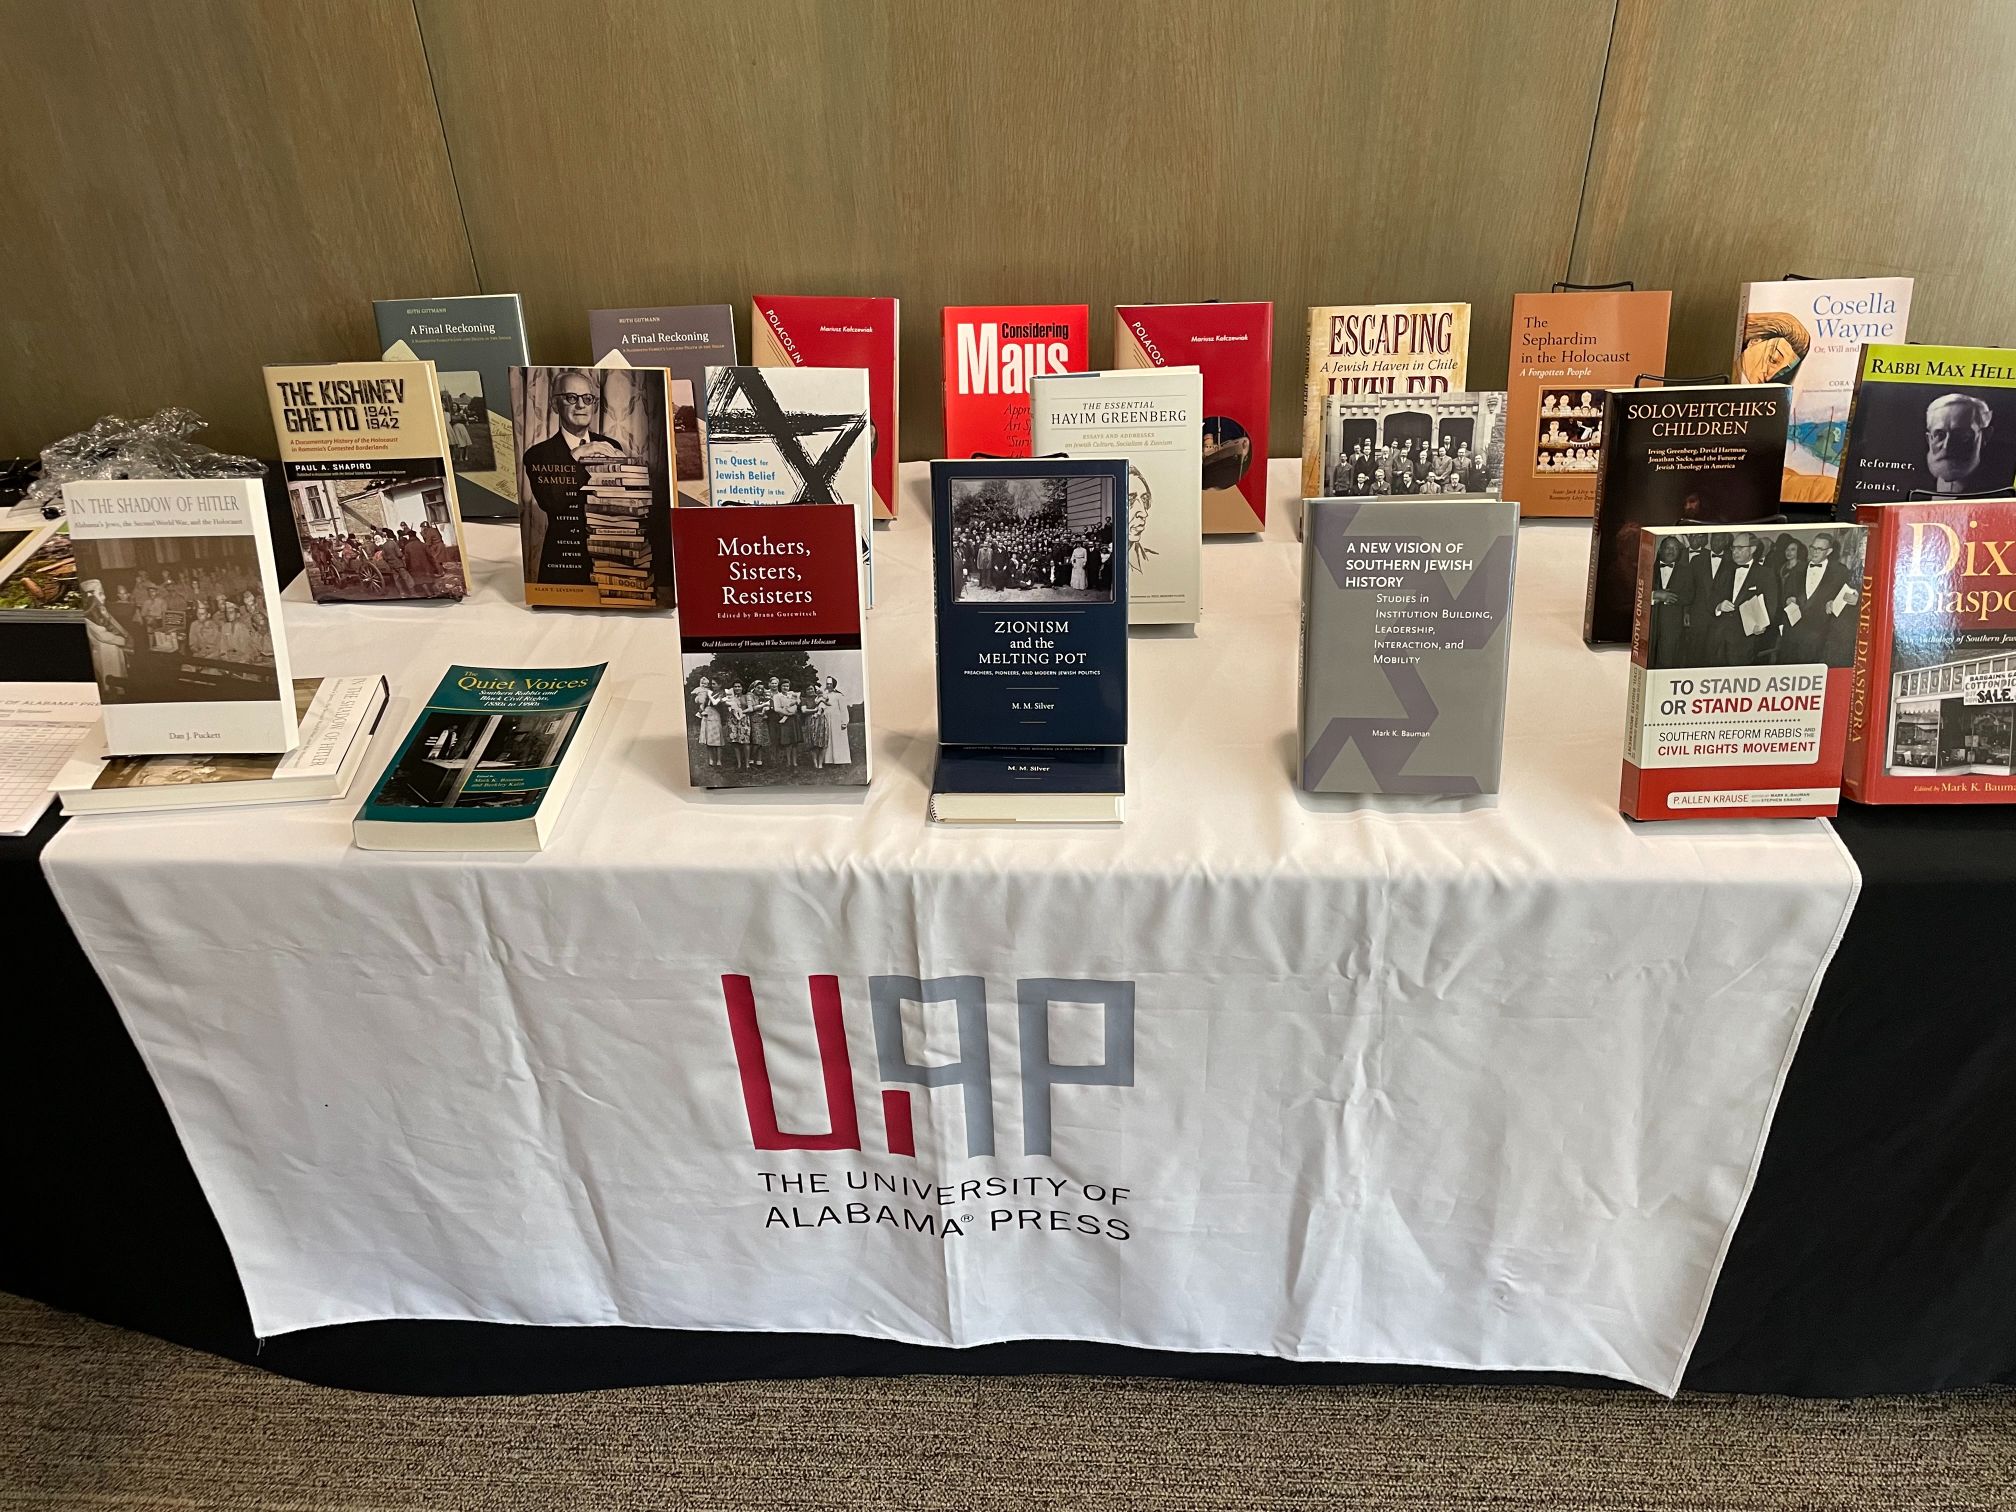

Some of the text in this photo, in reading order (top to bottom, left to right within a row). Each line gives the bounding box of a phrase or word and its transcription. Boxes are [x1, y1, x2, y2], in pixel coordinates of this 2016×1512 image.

[1813, 292, 1897, 316] Cosella
[410, 322, 496, 334] A Final Reckoning
[1524, 316, 1548, 328] The
[622, 331, 710, 344] A Final Reckoning
[766, 309, 804, 364] POLACOS IN
[1002, 322, 1069, 340] Considering
[1328, 312, 1453, 357] ESCAPING
[1815, 318, 1894, 344] Wayne
[1132, 321, 1165, 365] POLACOS
[1522, 332, 1597, 350] Sephardim
[1814, 346, 1826, 354] Or,
[1844, 344, 1860, 352] and
[957, 322, 1069, 394] Maus
[1521, 350, 1631, 363] in the Holocaust
[1320, 358, 1458, 374] A Jewish Haven in Chile
[1520, 367, 1592, 379] A Forgotten People
[1871, 358, 2016, 380] RABBI MAX HELL
[276, 378, 404, 407] THE KISHINEV
[1082, 401, 1155, 410] THE ESSENTIAL
[1627, 401, 1777, 420] SOLOVEITCHIK'S
[284, 406, 360, 432] GHETTO
[366, 418, 400, 430] 1942
[1051, 410, 1187, 424] HAYIM GREENBERG
[1652, 420, 1748, 436] CHILDREN
[532, 464, 577, 472] MAURICE
[730, 456, 757, 466] Quest
[1860, 458, 1915, 470] Reformer,
[538, 476, 578, 484] SAMUEL
[716, 470, 776, 480] Jewish Belief
[730, 485, 765, 497] Identity
[1855, 480, 1900, 492] Zionist,
[70, 495, 240, 514] IN THE SHADOW OF HITLER
[717, 536, 811, 557] Mothers,
[1346, 542, 1464, 554] A NEW VISION OF
[1906, 520, 2016, 576] Dix
[729, 561, 802, 582] Sisters,
[1346, 560, 1473, 574] SOUTHERN JEWISH
[1345, 576, 1404, 588] HISTORY
[722, 586, 812, 605] Resisters
[1376, 594, 1430, 603] STUDIES in
[1634, 579, 1645, 618] STAND
[1860, 575, 1873, 634] DIXIE
[1376, 609, 1493, 620] INSTITUTION BUILDING,
[994, 620, 1070, 634] ZIONISM
[1375, 624, 1436, 635] LEADERSHIP,
[1010, 636, 1055, 649] and the
[1374, 640, 1464, 650] INTERACTION, and
[1632, 619, 1642, 658] ALONE
[978, 652, 1087, 664] MELTING POT
[1373, 654, 1421, 664] MOBILITY
[457, 676, 589, 691] Quiet Voices
[1970, 673, 2006, 682] BARGAINS
[1670, 676, 1824, 696] TO STAND ASIDE
[1852, 642, 1869, 742] DIASPORA
[1965, 680, 2000, 690] COTTON
[1976, 688, 2014, 704] SALE.
[1034, 702, 1055, 710] Silver
[1660, 695, 1822, 716] OR STAND ALONE
[1658, 730, 1716, 742] SOUTHERN
[1718, 728, 1761, 740] REFORM
[1764, 728, 1802, 738] RABBIS
[1658, 742, 1816, 756] CIVIL RIGHTS MOVEMENT
[1673, 796, 1681, 804] P.
[1681, 795, 1710, 804] ALLEN
[1714, 794, 1749, 804] KRAUSE
[758, 1170, 1132, 1206] THE UNIVERSITY OF
[990, 1208, 1132, 1241] PRESS
